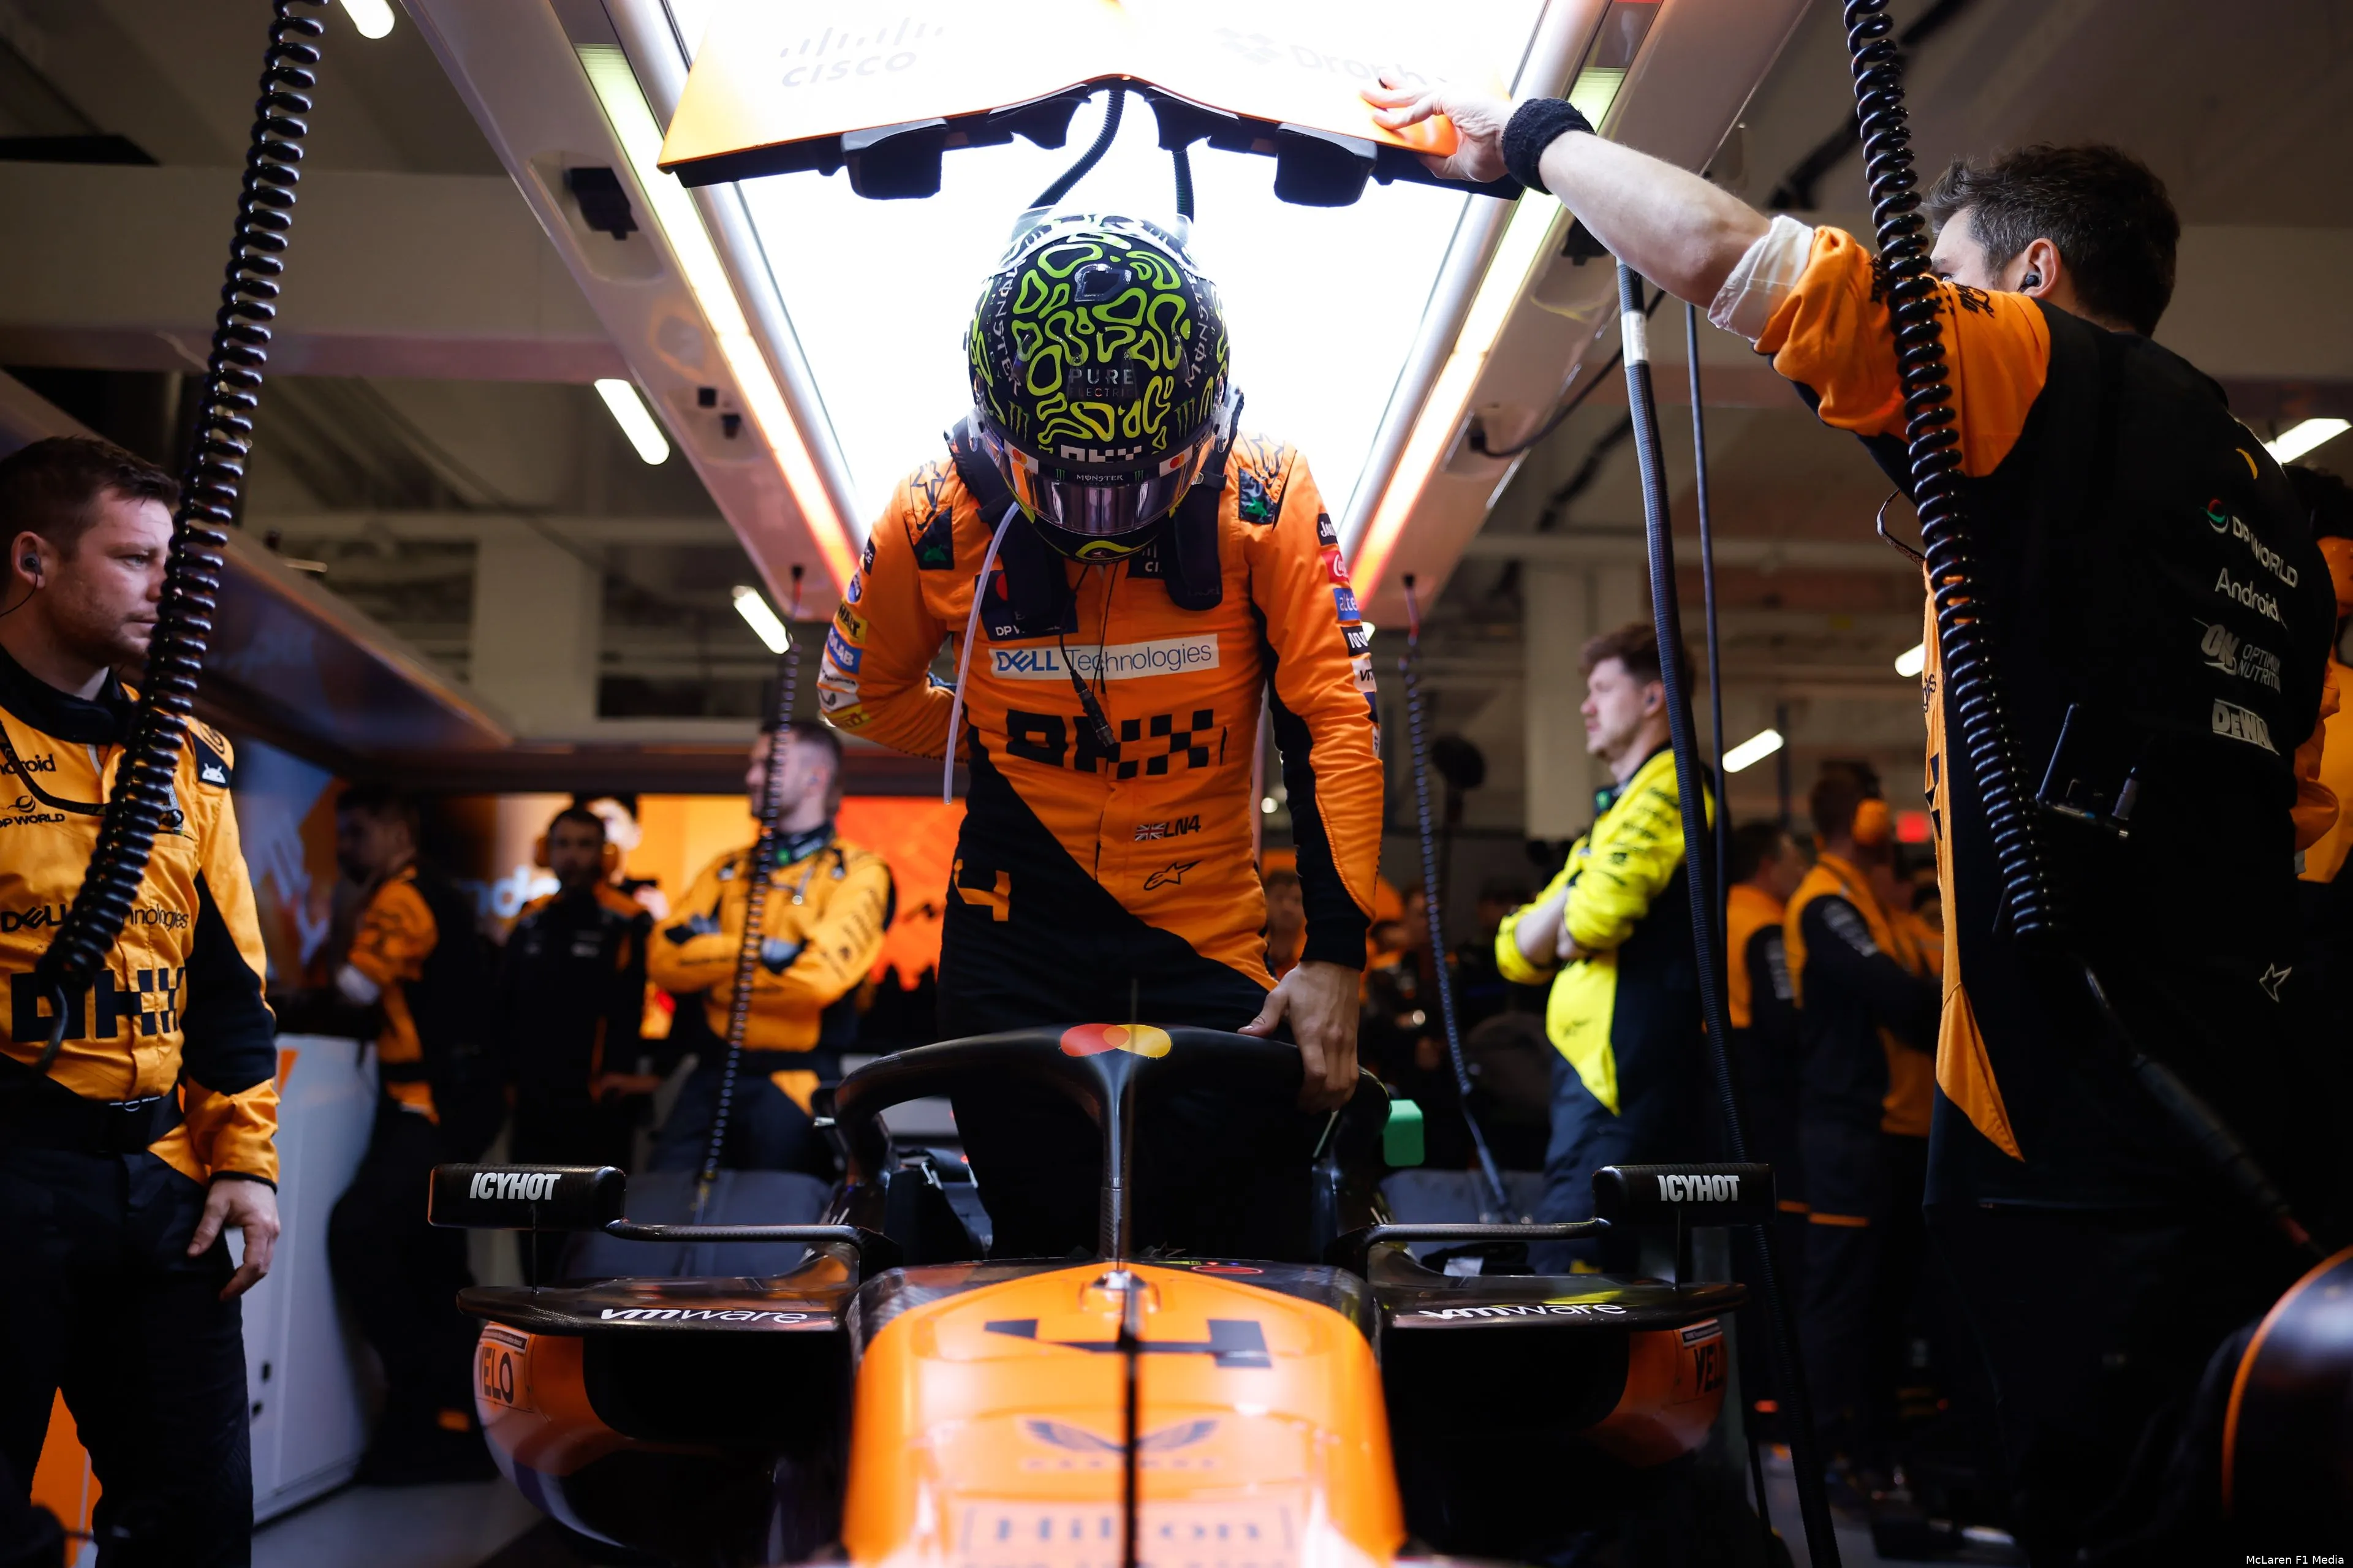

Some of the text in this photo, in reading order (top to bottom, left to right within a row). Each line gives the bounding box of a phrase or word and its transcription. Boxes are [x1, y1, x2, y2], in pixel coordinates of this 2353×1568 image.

[1182, 270, 1208, 388] MONSTE
[1069, 368, 1134, 385] PURE
[1070, 387, 1134, 398] ELECTRIC
[2232, 515, 2298, 588] DP WORLD
[2214, 567, 2280, 622] Android
[996, 643, 1212, 673] DELL Technologies
[14, 813, 65, 826] WORLD
[1164, 814, 1201, 838] LN4
[469, 1172, 563, 1201] ICYHOT
[1657, 1174, 1740, 1202] ICYHOT
[601, 1308, 808, 1324] vmware
[1418, 1305, 1627, 1320] vmware
